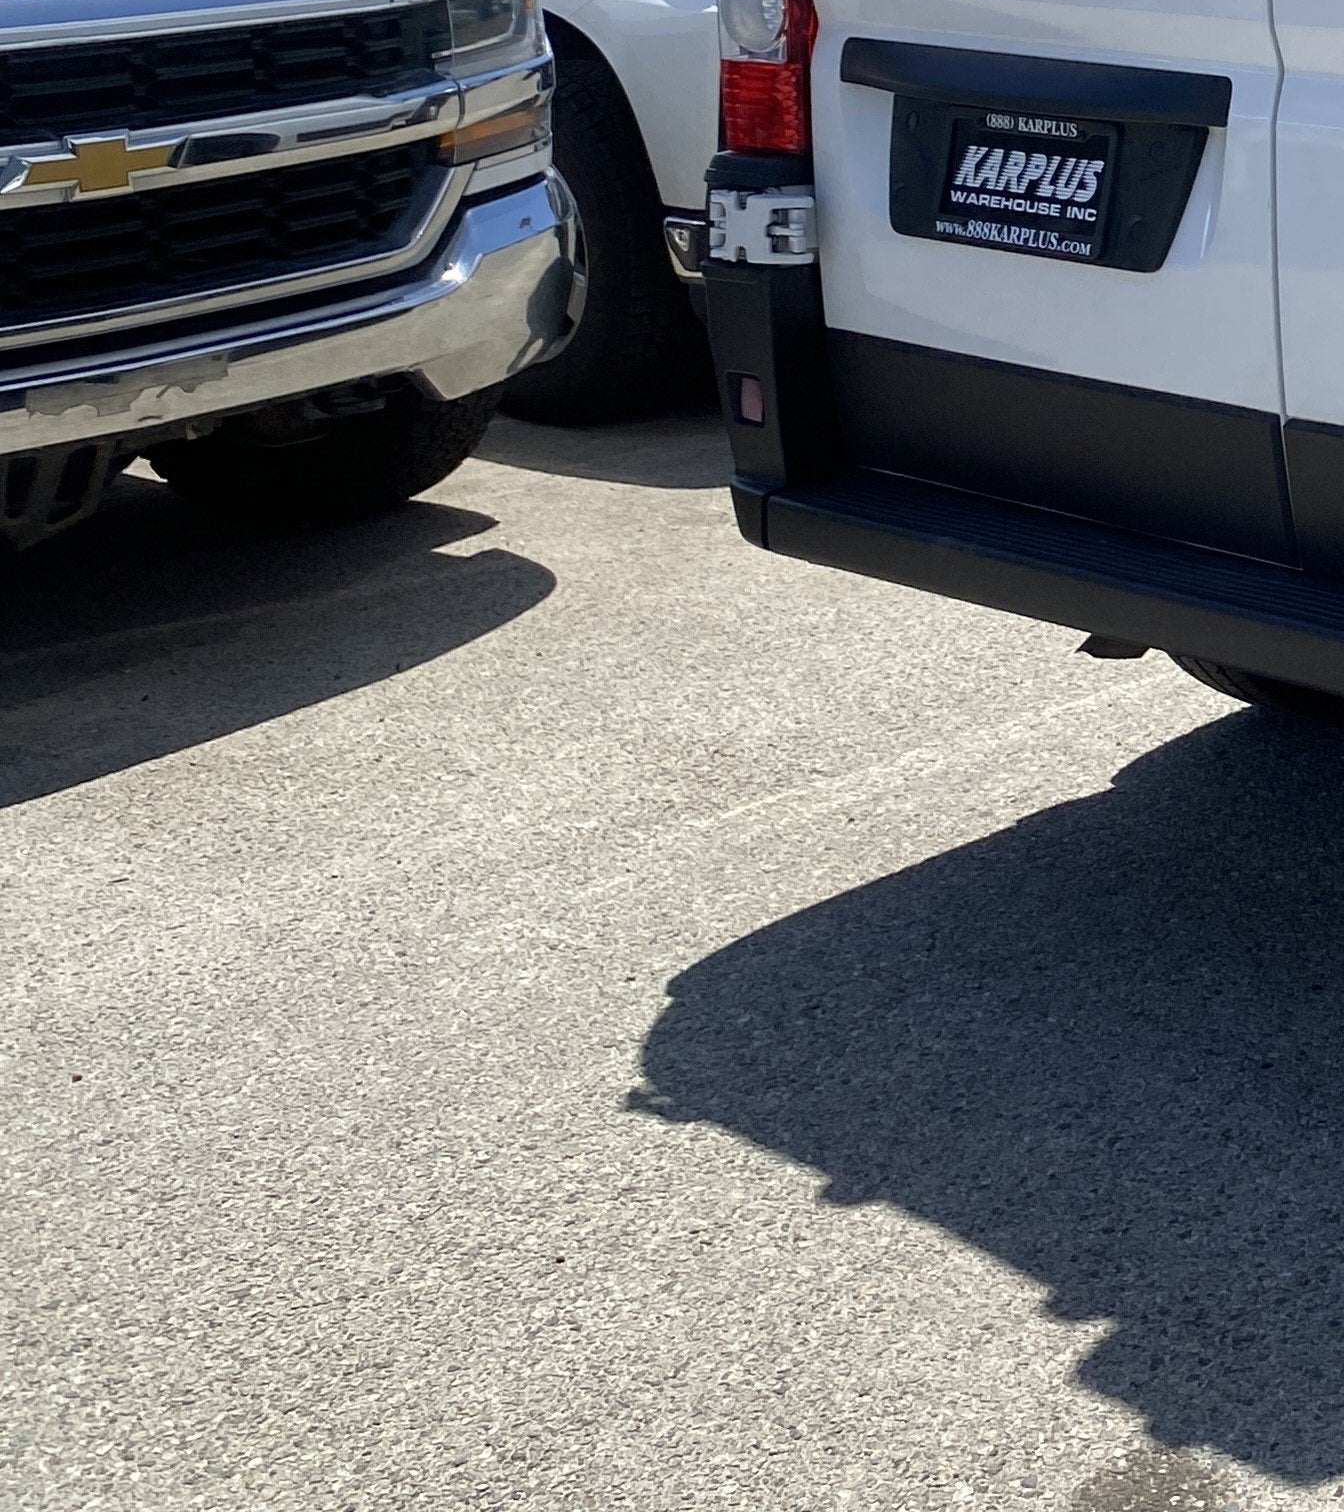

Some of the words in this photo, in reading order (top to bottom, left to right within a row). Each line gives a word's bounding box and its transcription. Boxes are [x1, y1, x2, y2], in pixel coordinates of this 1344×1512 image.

[986, 113, 1014, 130] (888)
[1018, 116, 1078, 137] KARPLUS
[952, 145, 1105, 203] KARPLUS
[950, 190, 1061, 217] WAREHOUSE
[1066, 205, 1098, 222] INC
